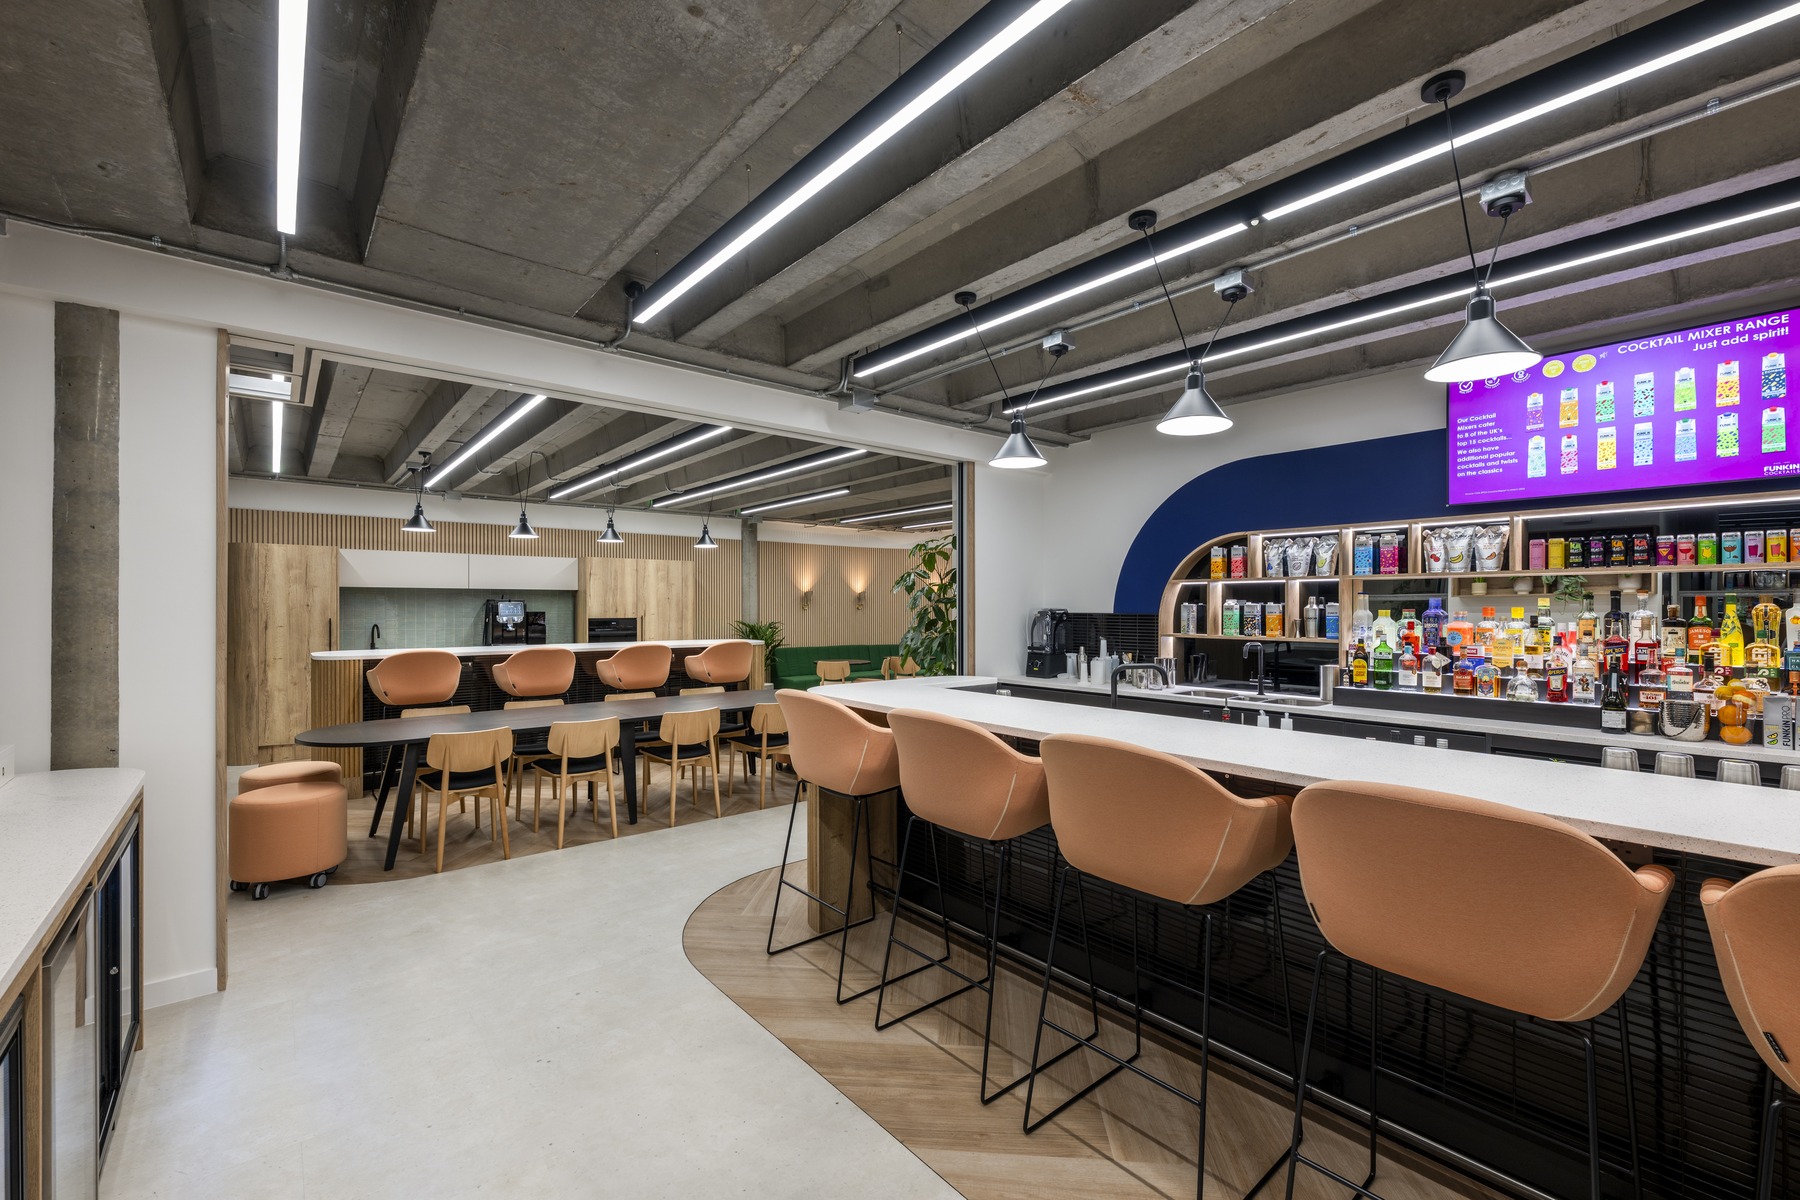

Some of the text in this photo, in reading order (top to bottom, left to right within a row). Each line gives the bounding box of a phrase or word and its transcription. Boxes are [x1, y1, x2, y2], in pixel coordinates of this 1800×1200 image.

[1617, 314, 1790, 354] COCKTAIL MIXER RANGE
[1692, 325, 1790, 352] Just add spirit!
[1469, 413, 1497, 422] Cocktail
[1457, 451, 1516, 463] additional popular
[1457, 462, 1485, 470] cocktails
[1763, 463, 1800, 473] FUNKIN
[1782, 705, 1791, 747] FUNKIN PRO
